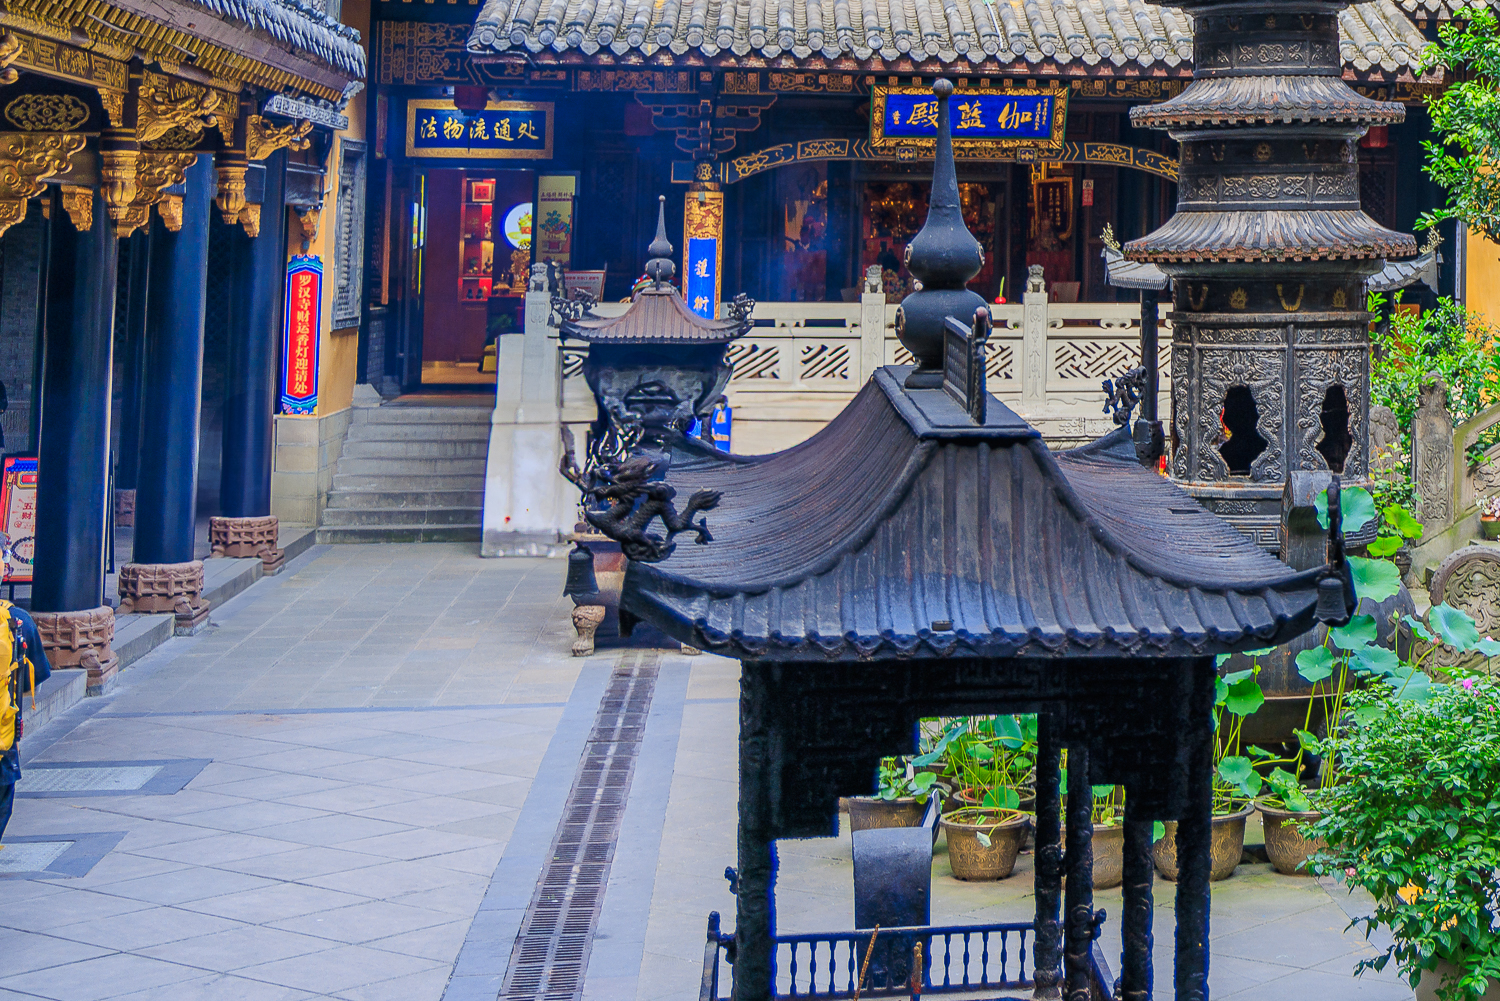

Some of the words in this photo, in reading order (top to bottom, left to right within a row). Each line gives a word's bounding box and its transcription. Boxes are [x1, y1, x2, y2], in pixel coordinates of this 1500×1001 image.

[420, 116, 540, 142] 法物流通处
[293, 274, 312, 395] 罗汉寺财运香灯迎请处
